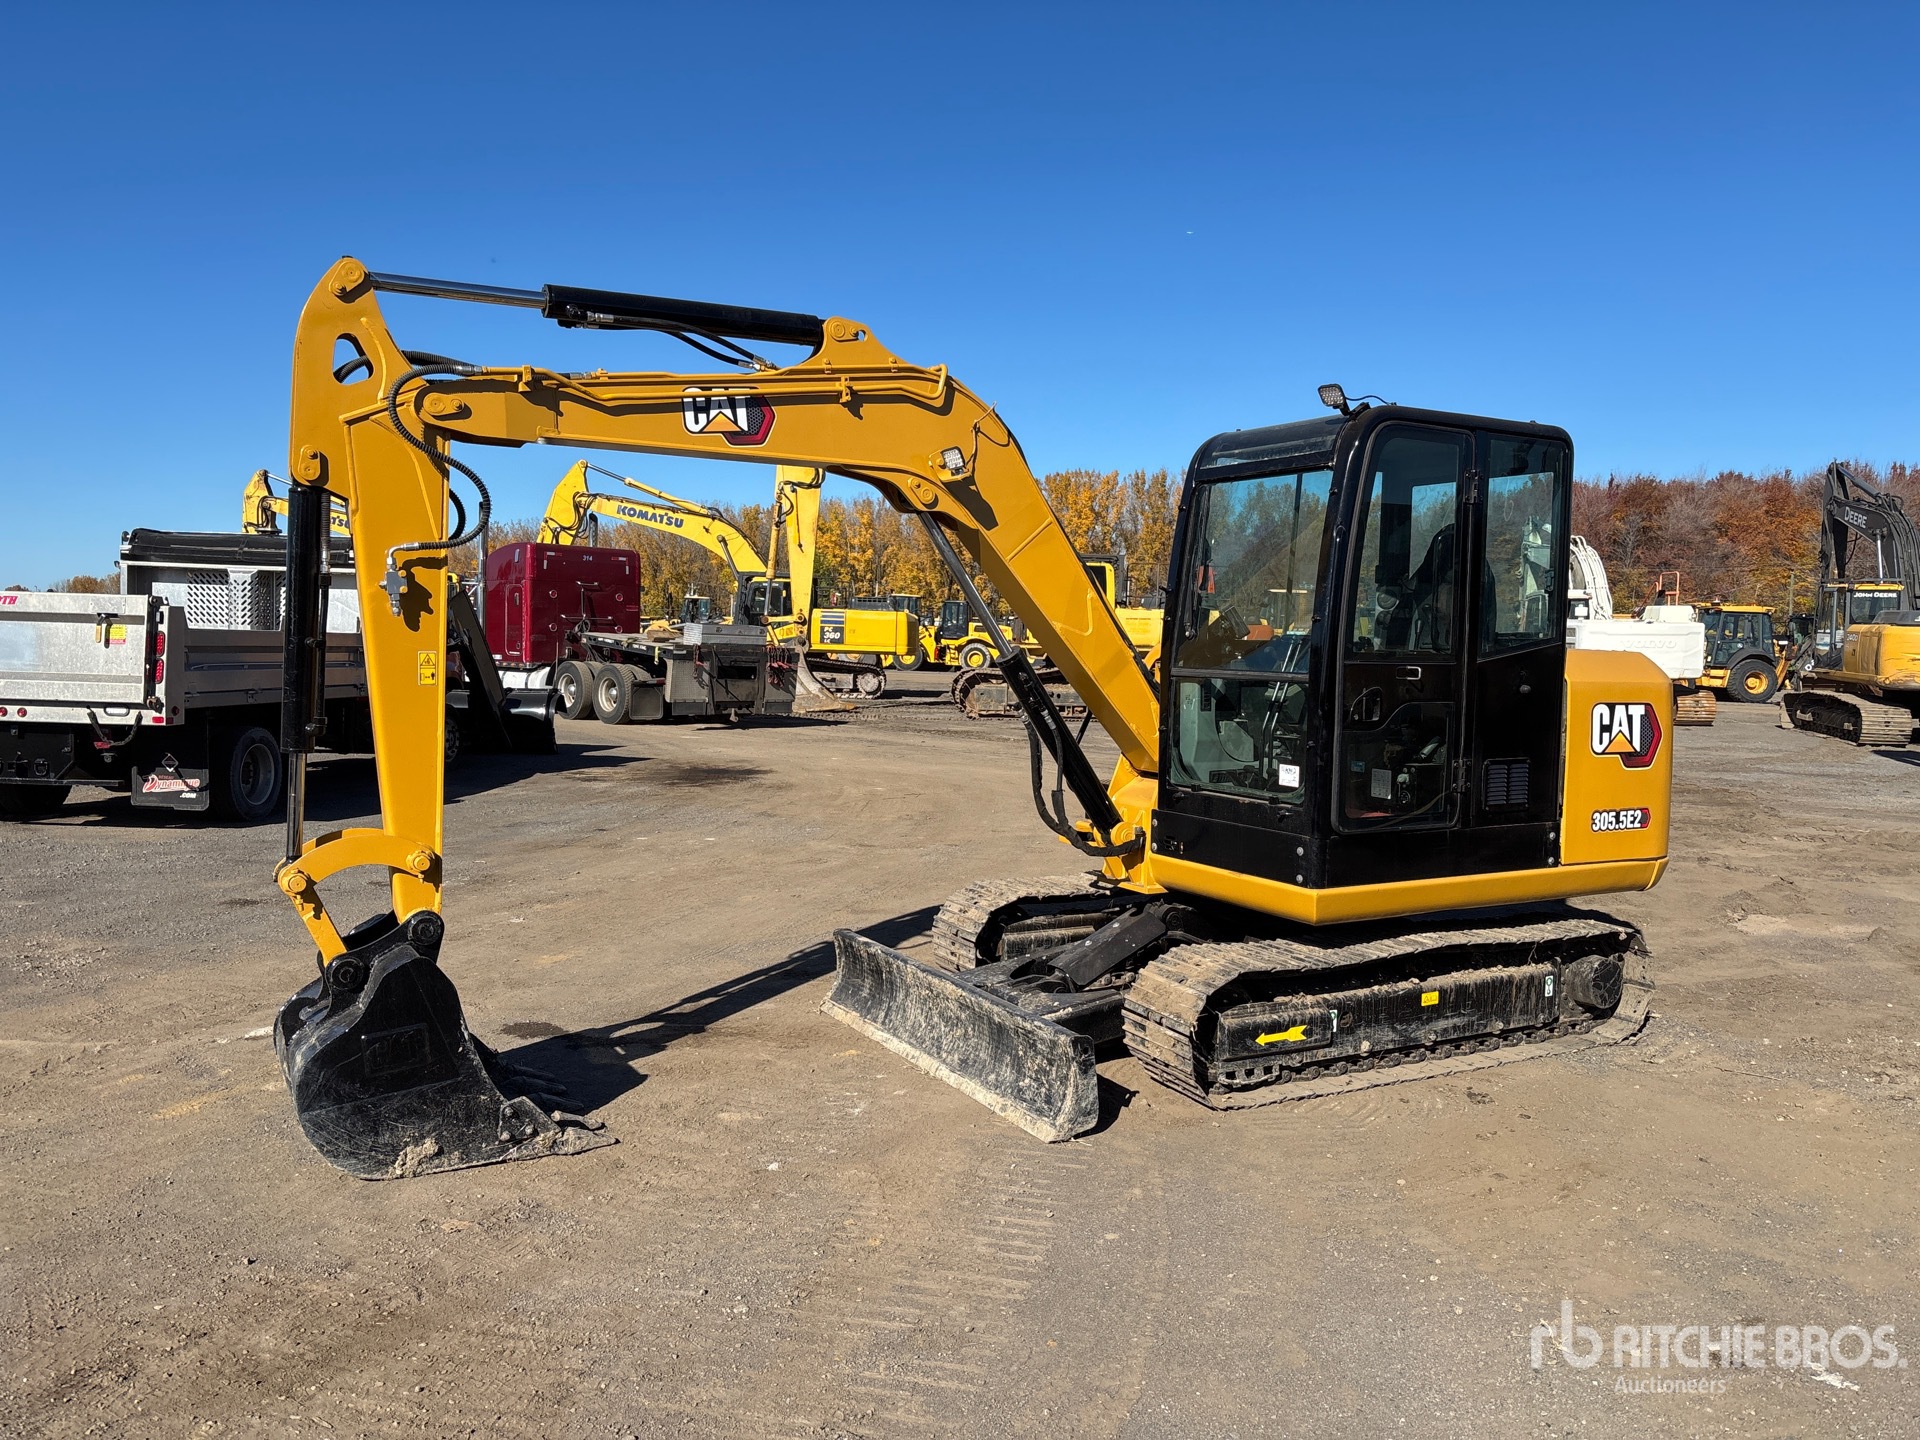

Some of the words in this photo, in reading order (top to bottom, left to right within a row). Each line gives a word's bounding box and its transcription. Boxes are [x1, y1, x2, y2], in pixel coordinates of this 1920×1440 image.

[682, 387, 751, 433] CAT
[616, 504, 684, 529] KOMATSU
[1844, 506, 1868, 529] DEERE
[823, 631, 841, 640] 360
[1620, 639, 1678, 648] VOLVO
[1591, 703, 1646, 753] CAT
[1592, 809, 1642, 831] 305.5E2
